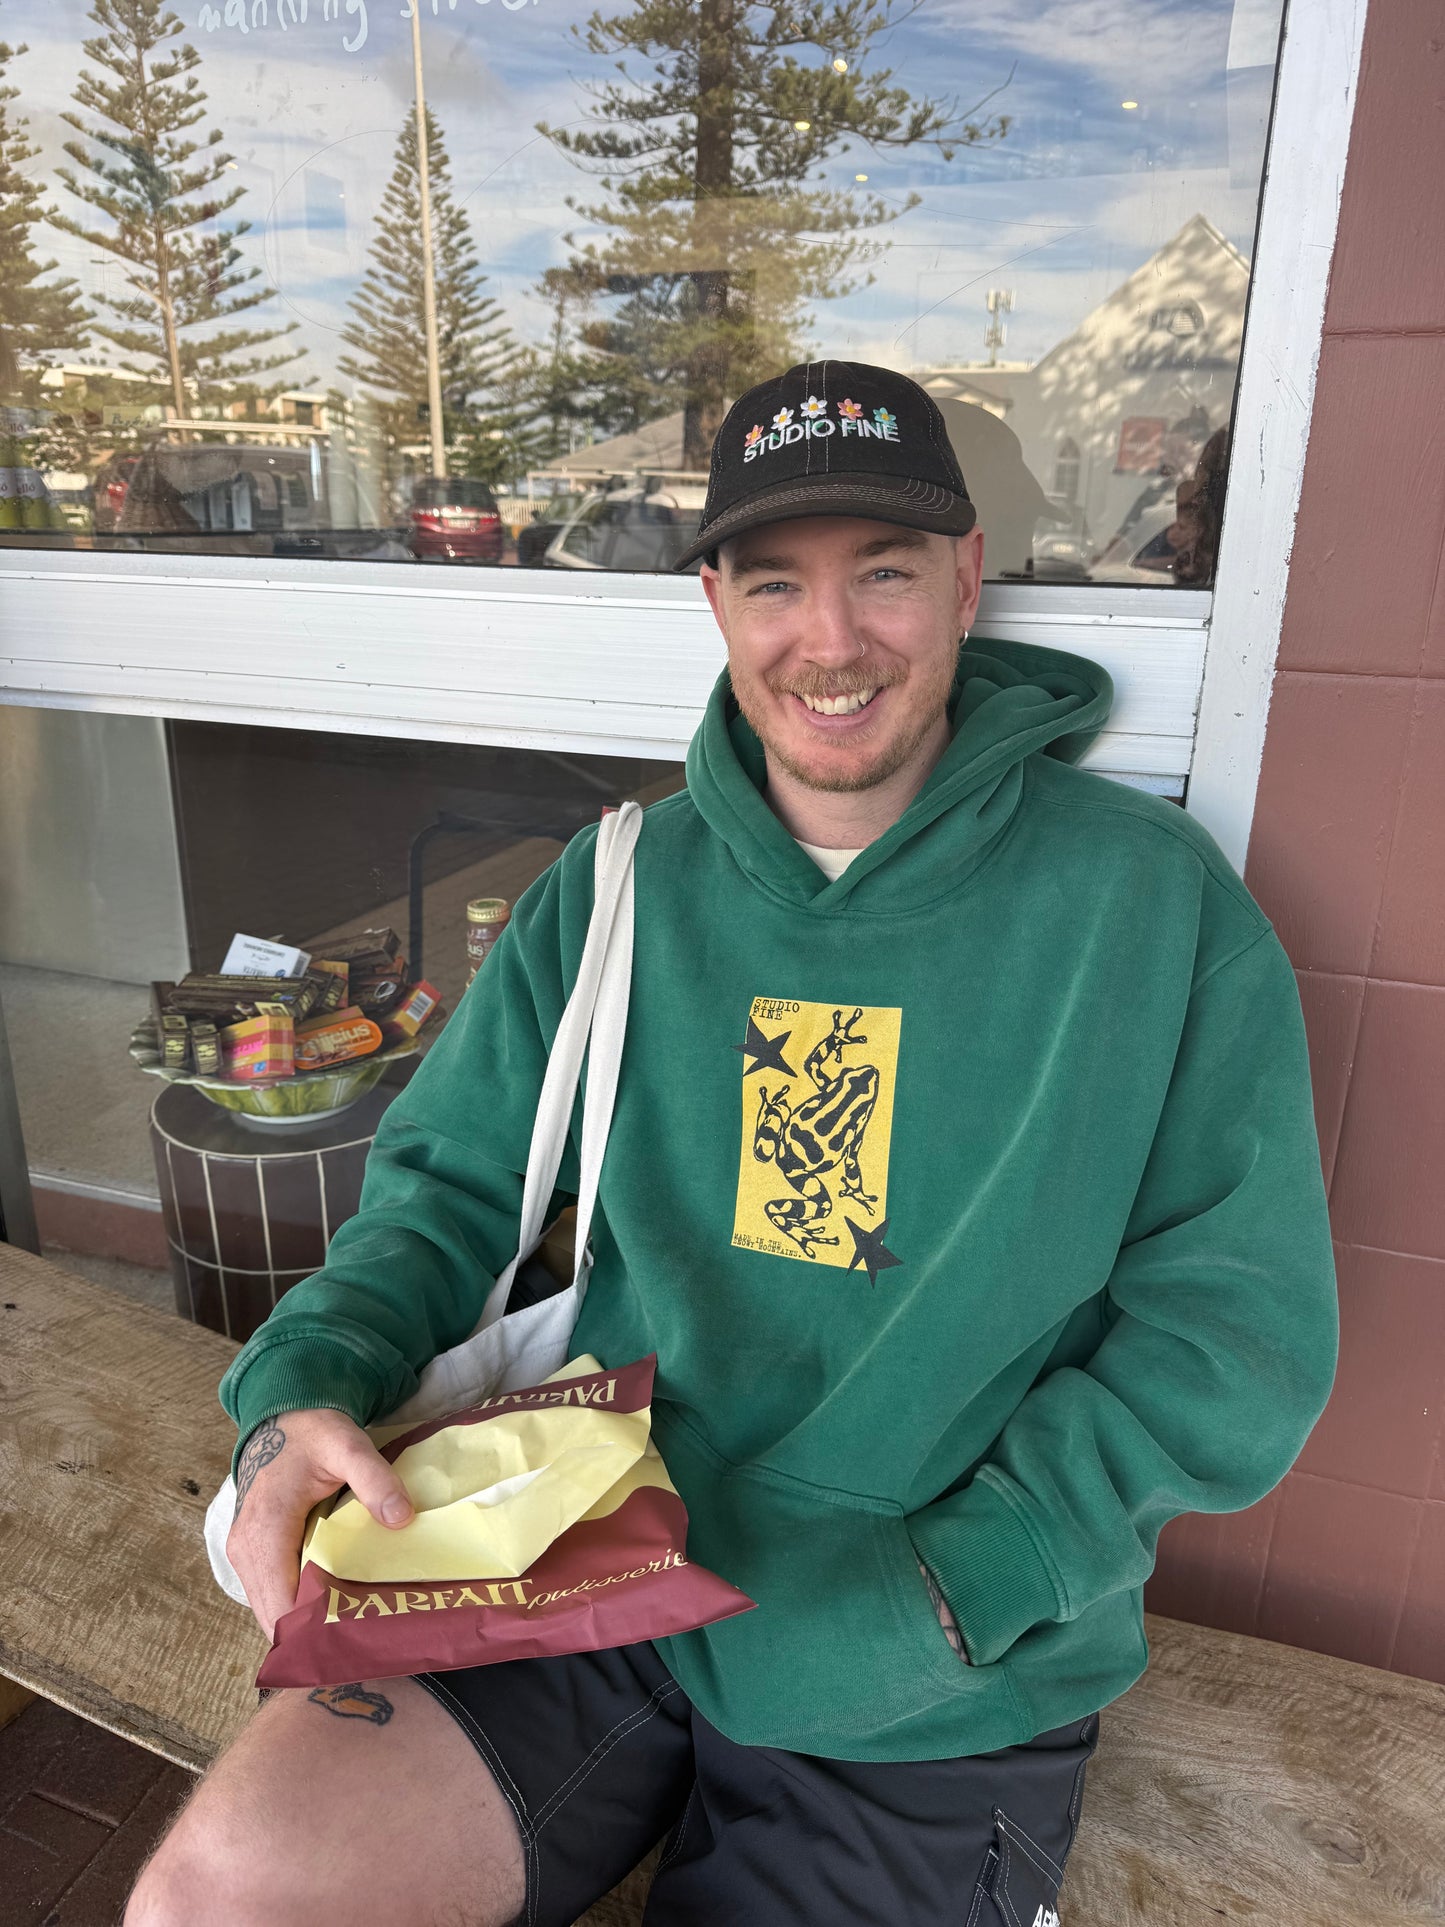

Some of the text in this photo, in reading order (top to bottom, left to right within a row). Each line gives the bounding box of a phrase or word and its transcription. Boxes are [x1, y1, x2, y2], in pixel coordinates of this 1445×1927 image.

[743, 418, 901, 463] STUDIO FINE
[754, 998, 800, 1013] STUDIO
[752, 1006, 783, 1021] FINE
[734, 1233, 751, 1241] MADE
[323, 1578, 534, 1625] PARFAIT
